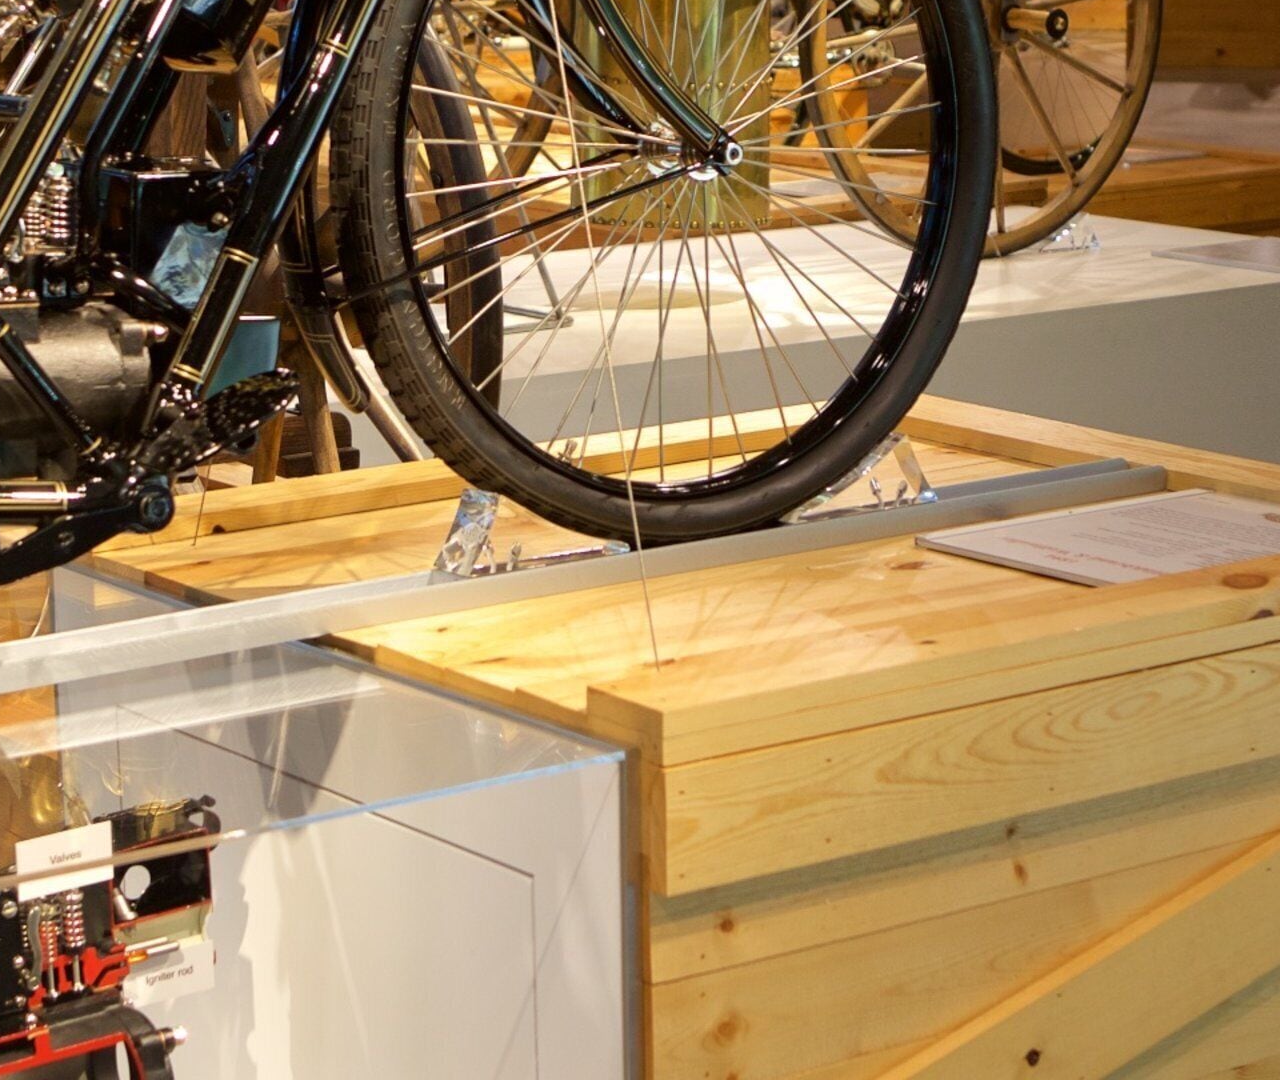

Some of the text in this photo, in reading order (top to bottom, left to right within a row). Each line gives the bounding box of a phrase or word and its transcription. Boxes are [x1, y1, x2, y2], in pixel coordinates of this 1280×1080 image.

[49, 851, 82, 865] Valves
[145, 965, 194, 986] Igniter rod
